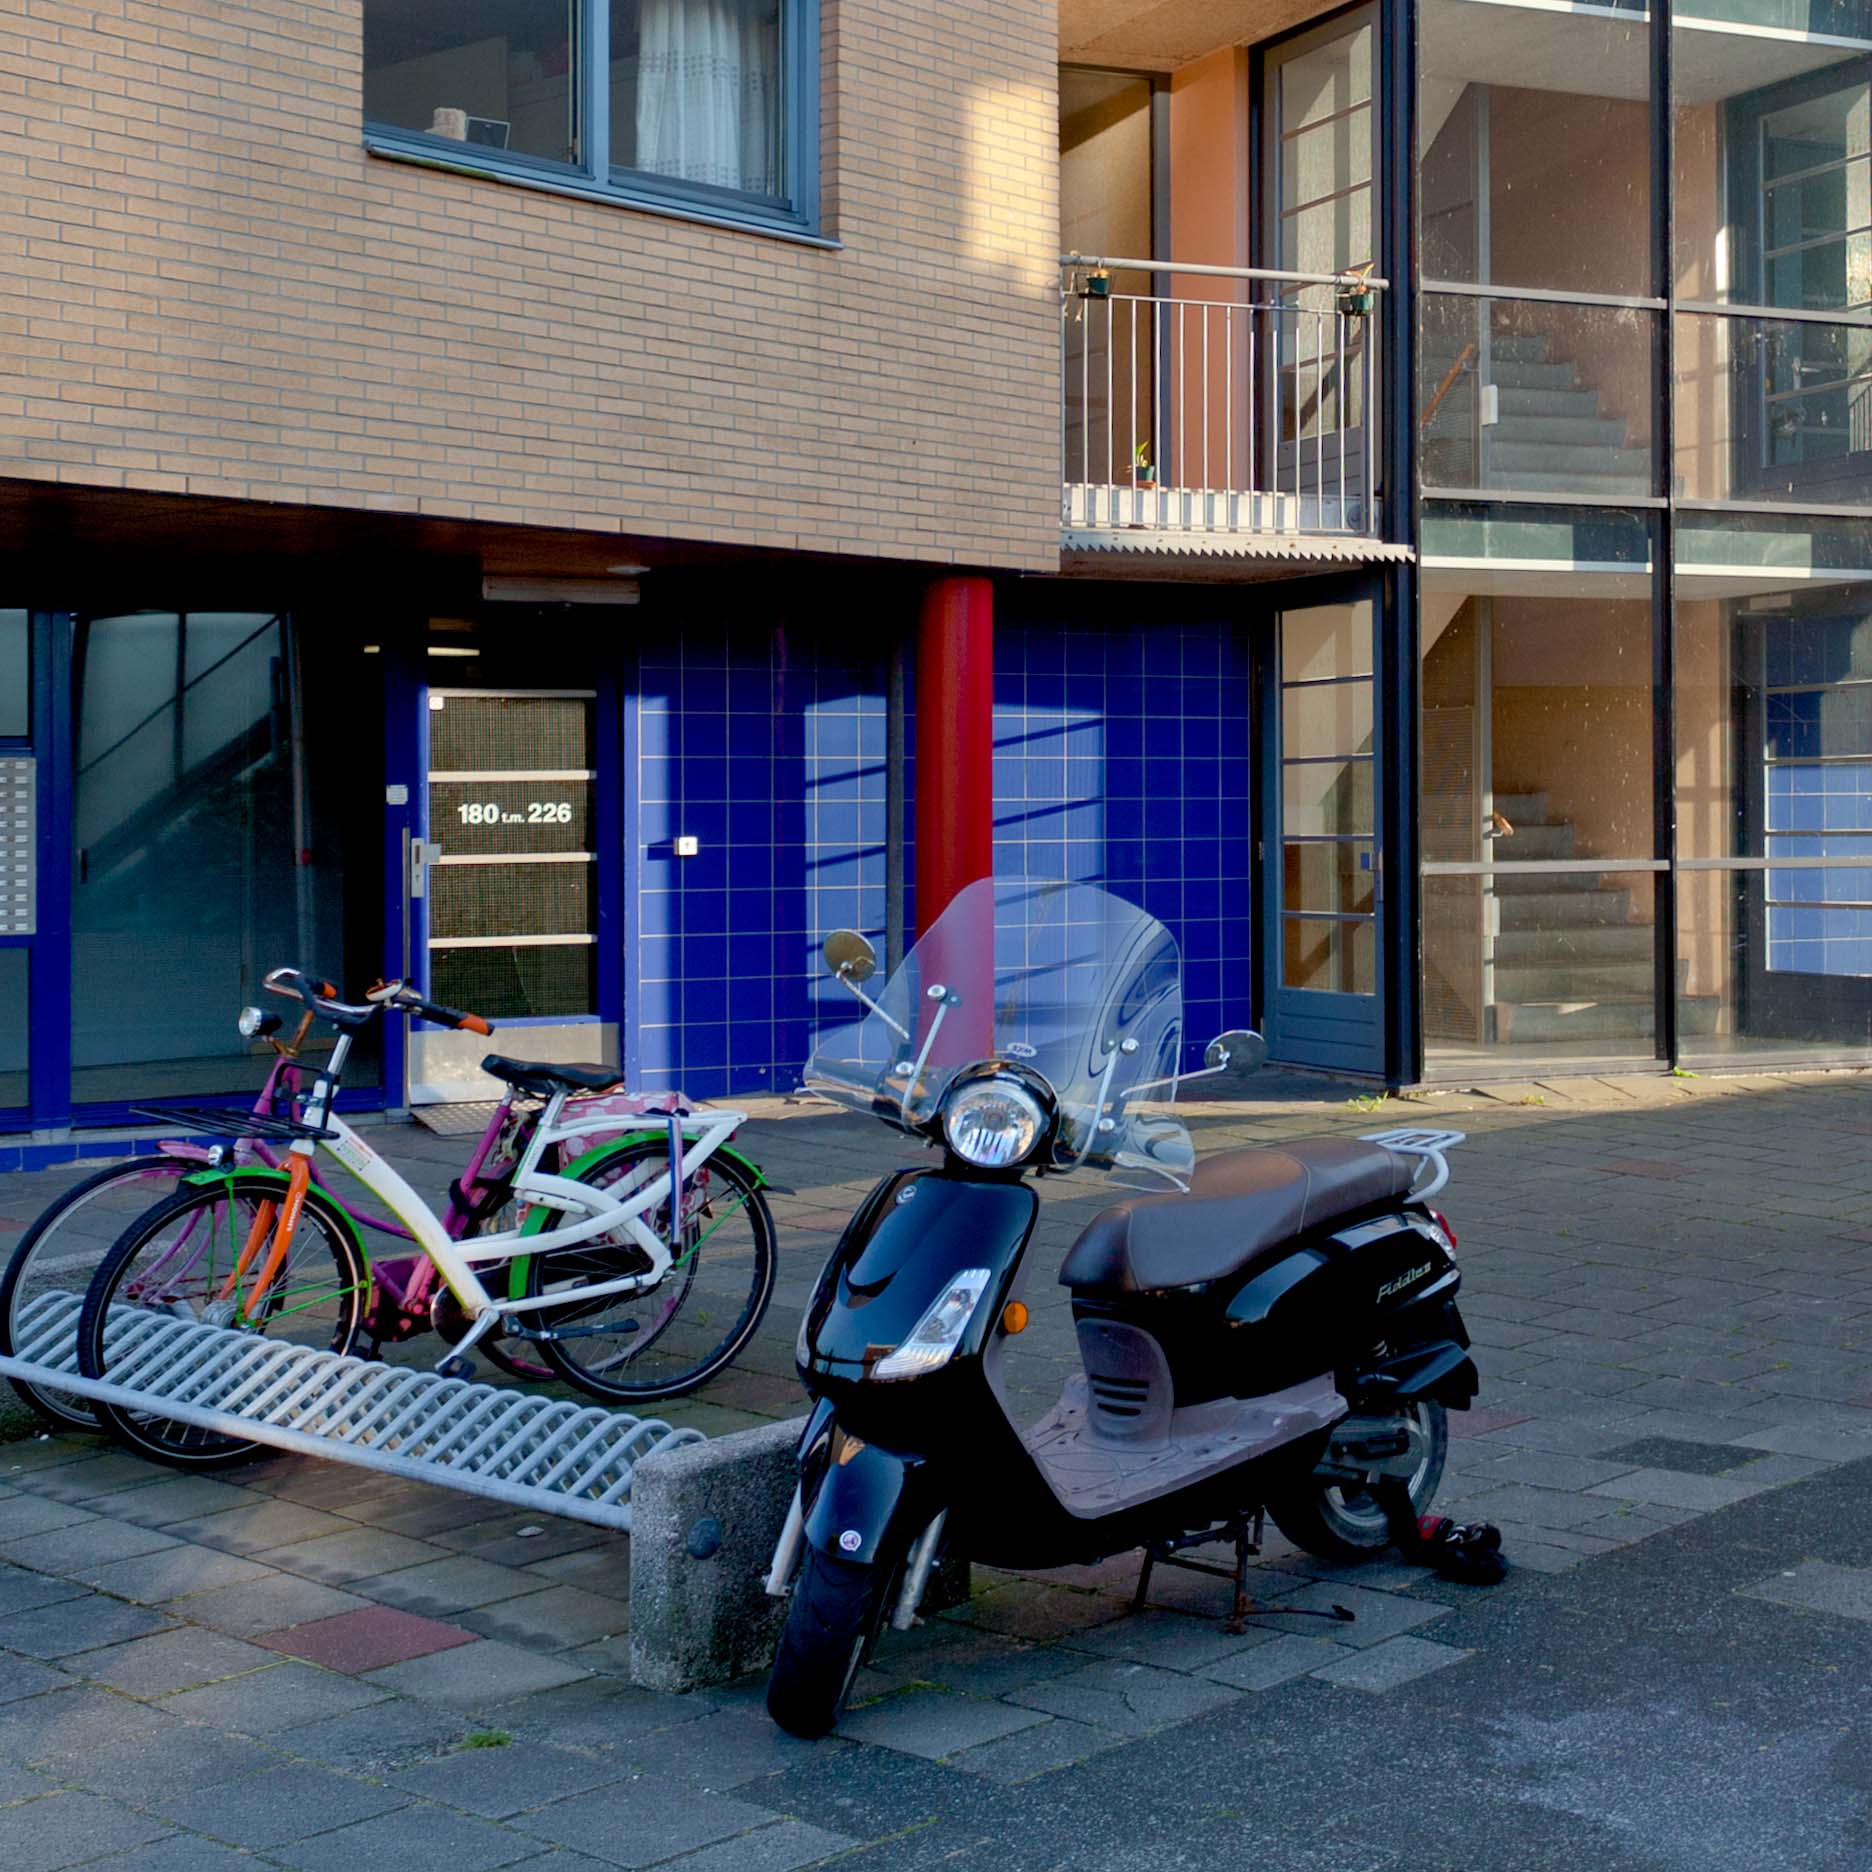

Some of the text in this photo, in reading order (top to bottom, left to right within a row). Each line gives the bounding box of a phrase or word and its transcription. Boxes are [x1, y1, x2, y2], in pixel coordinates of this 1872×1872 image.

[457, 802, 572, 824] 180 t.m. 226
